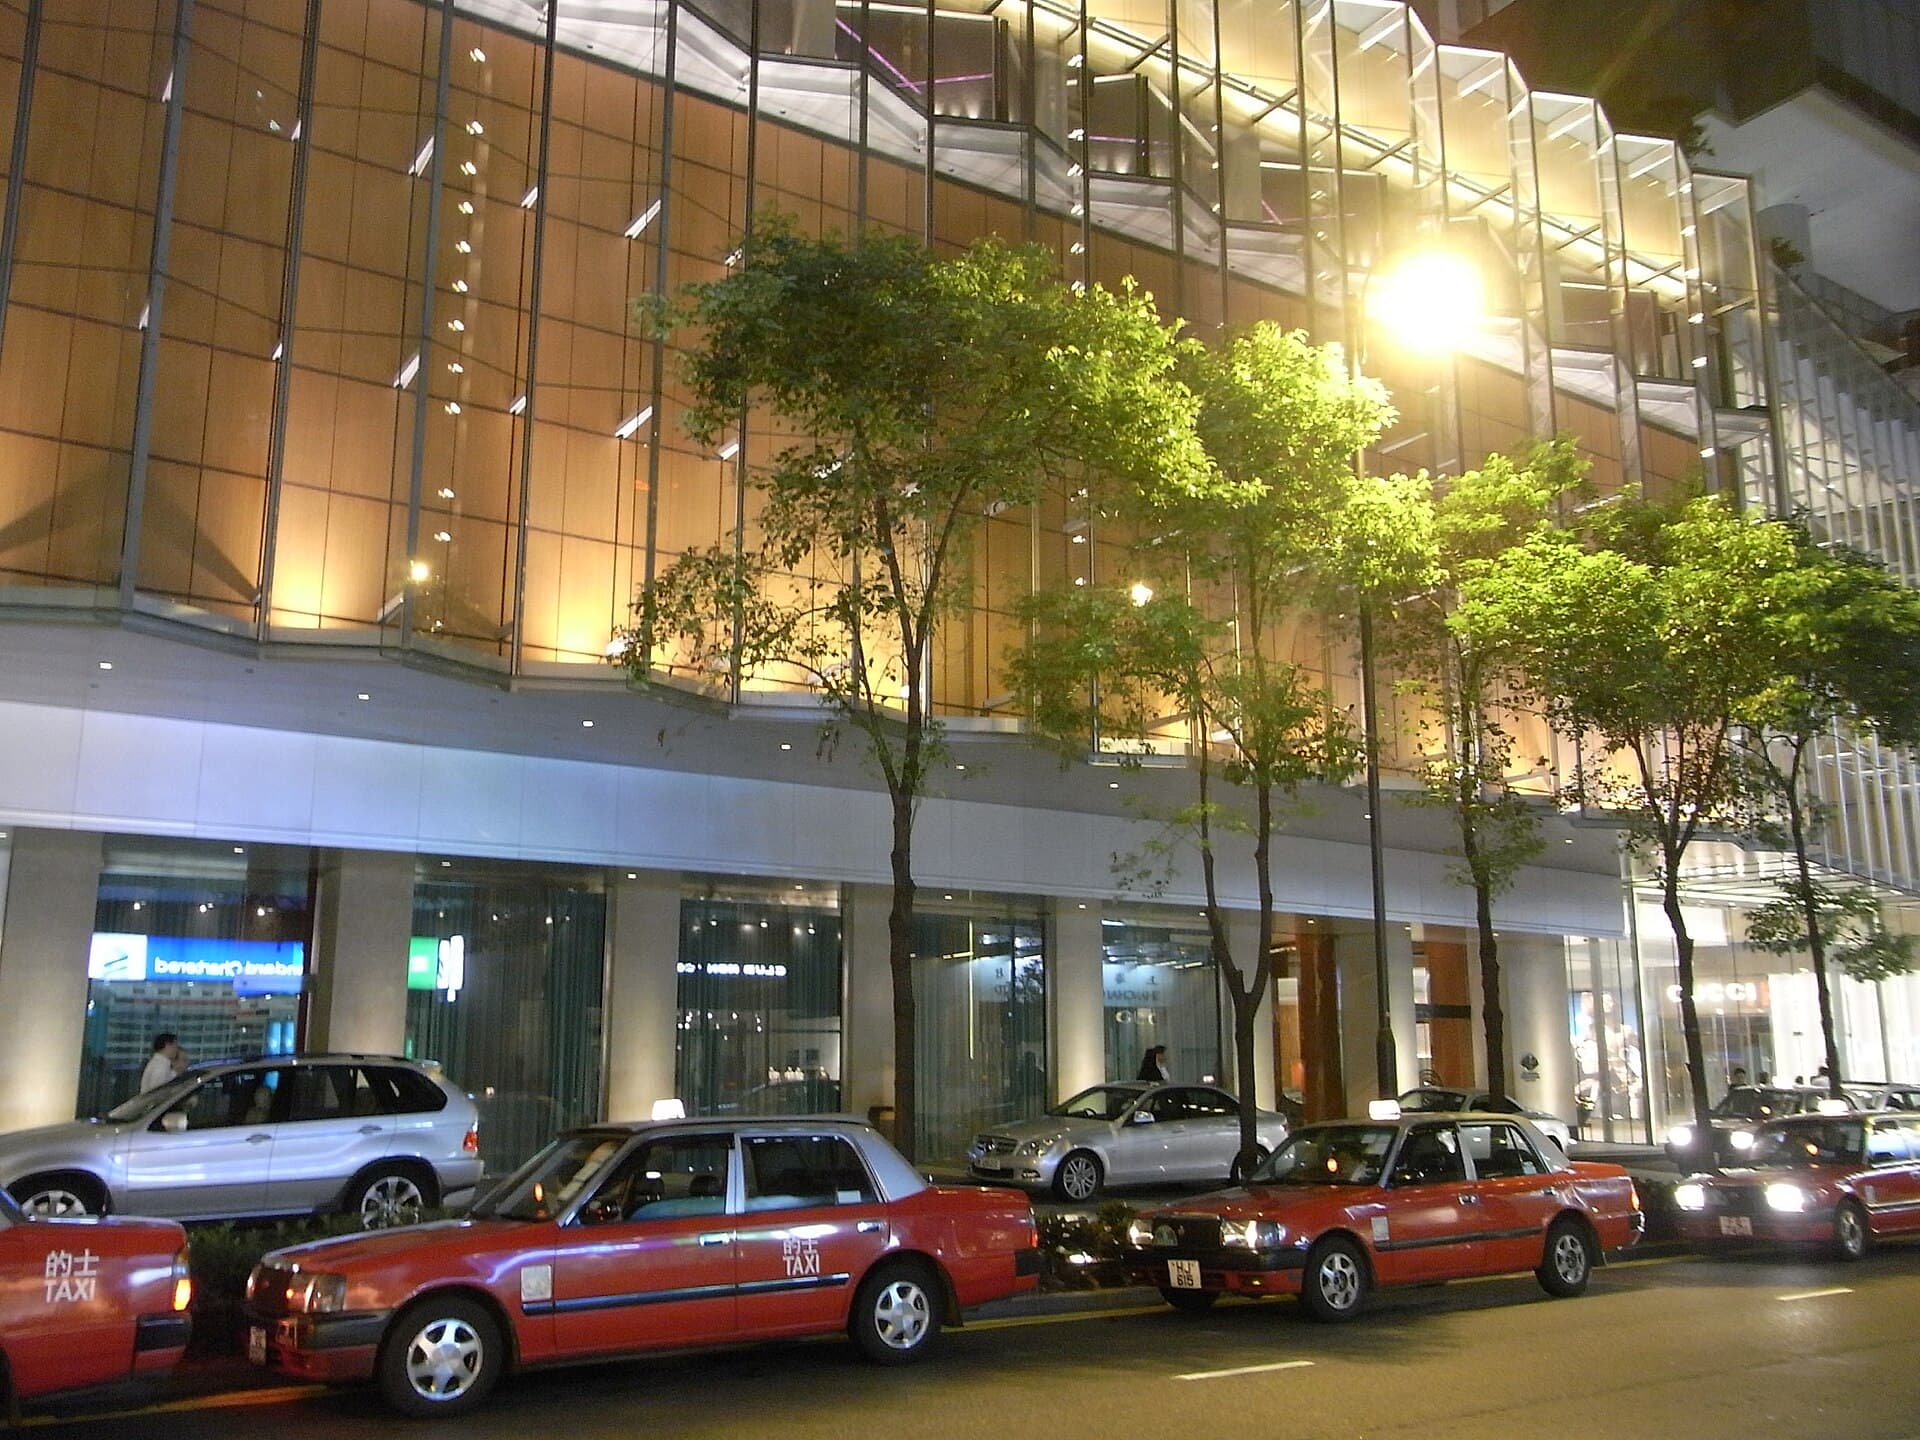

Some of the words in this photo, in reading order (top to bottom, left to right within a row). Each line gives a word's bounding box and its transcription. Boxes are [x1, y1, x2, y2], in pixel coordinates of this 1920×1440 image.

[45, 1248, 99, 1278] 的士
[782, 1252, 820, 1276] TAXI
[1175, 1261, 1192, 1274] HJ
[44, 1278, 97, 1303] TAXI
[1176, 1274, 1194, 1287] 615
